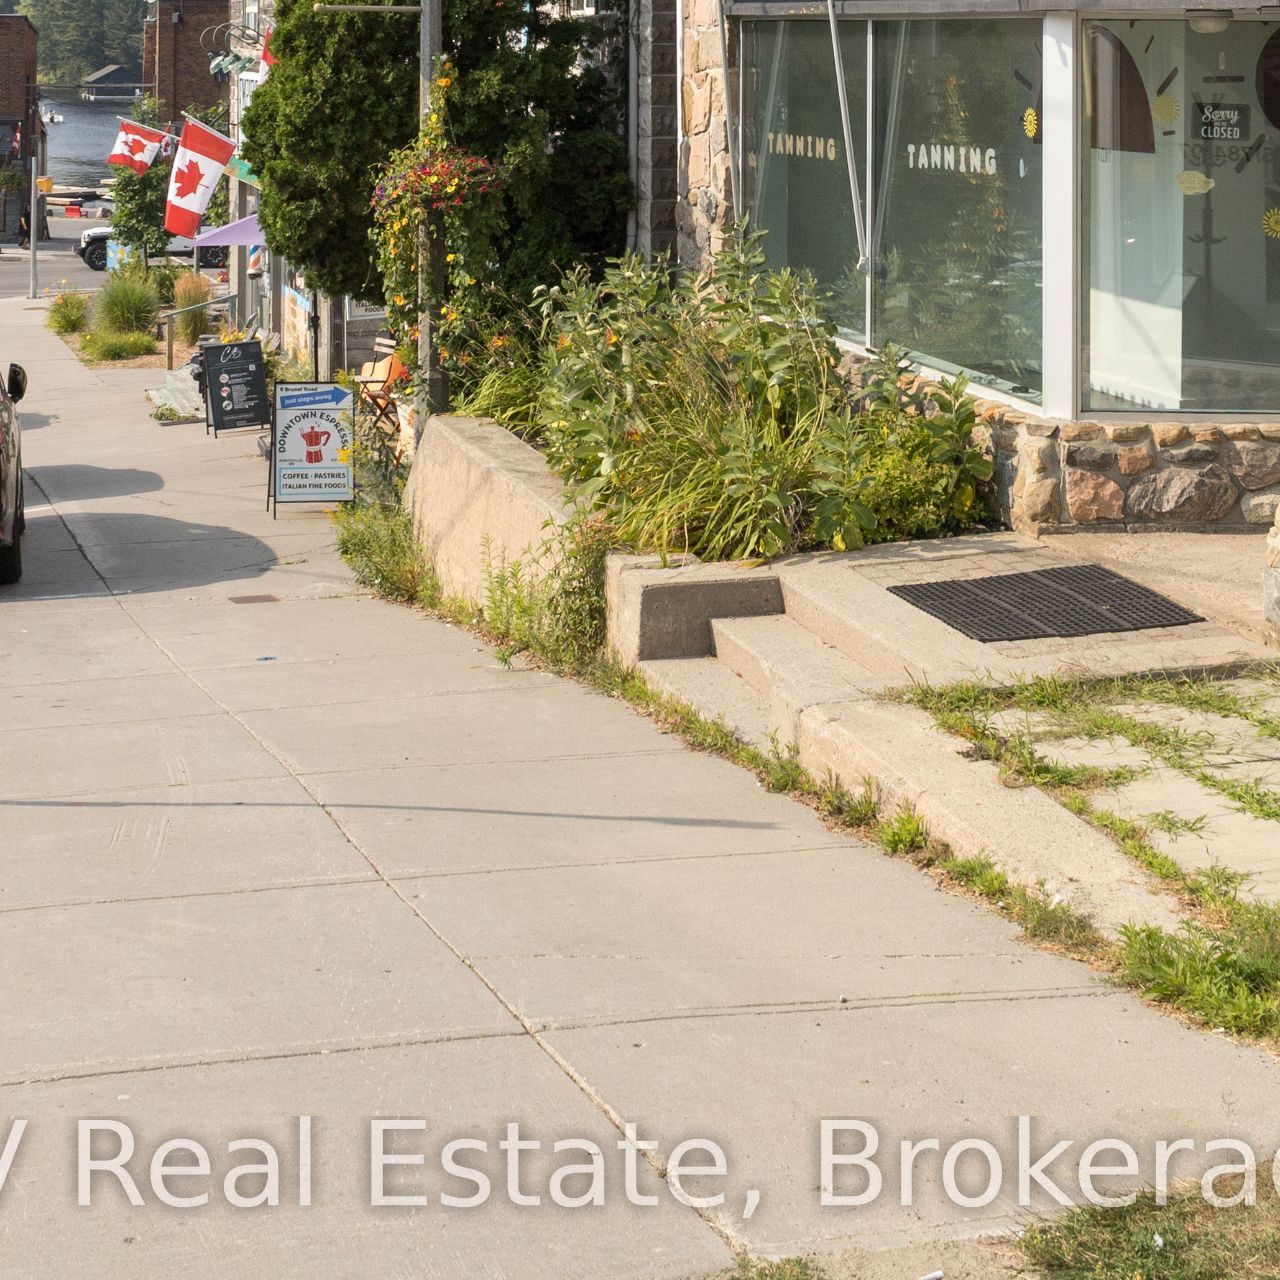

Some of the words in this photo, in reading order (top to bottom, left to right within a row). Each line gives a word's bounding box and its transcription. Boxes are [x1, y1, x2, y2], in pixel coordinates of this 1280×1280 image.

[1201, 105, 1240, 124] Sorry
[767, 132, 836, 161] TANNING
[1201, 126, 1240, 139] CLOSED
[907, 143, 997, 176] TANNING
[278, 410, 317, 453] DOWNTOWN
